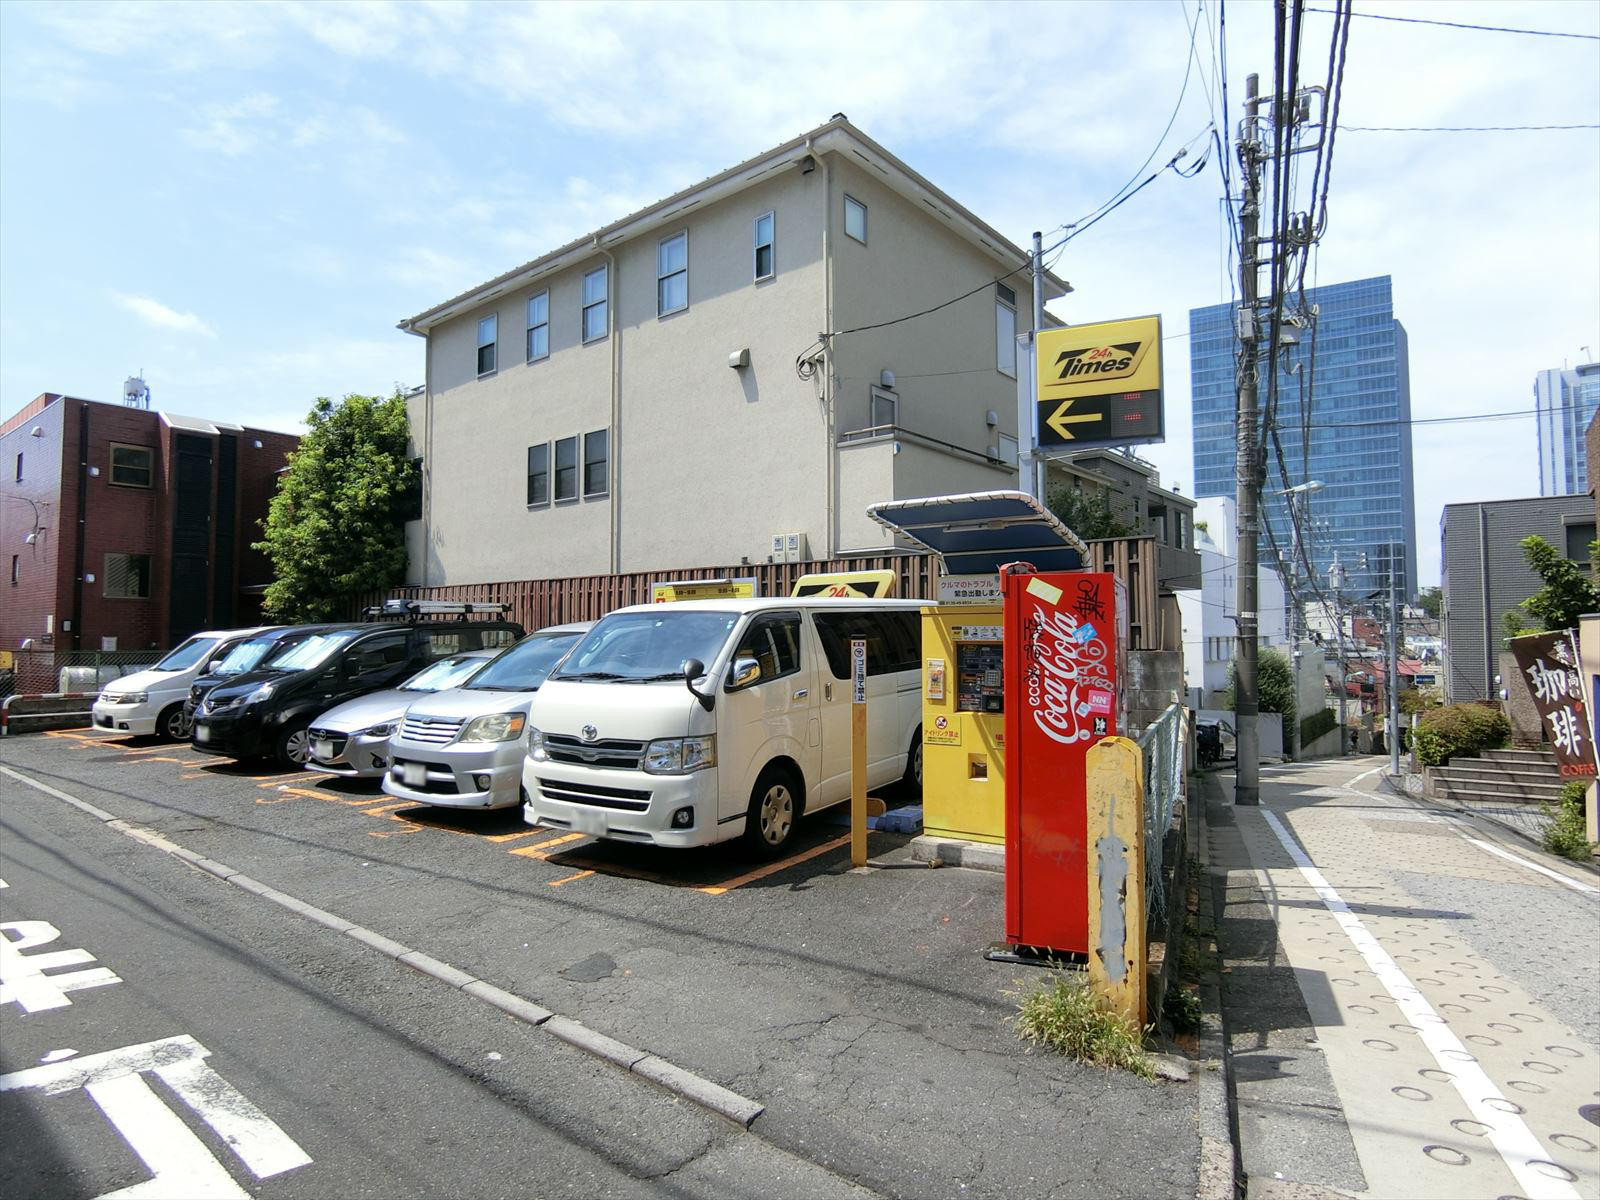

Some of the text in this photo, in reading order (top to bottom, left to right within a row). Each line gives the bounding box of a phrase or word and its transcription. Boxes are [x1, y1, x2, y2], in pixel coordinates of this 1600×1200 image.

[1055, 351, 1133, 379] Times
[1088, 347, 1113, 361] 24h
[940, 579, 994, 589] クルマのトラブル
[1033, 604, 1079, 744] Coca-Cola
[1526, 658, 1582, 757] 珈琲
